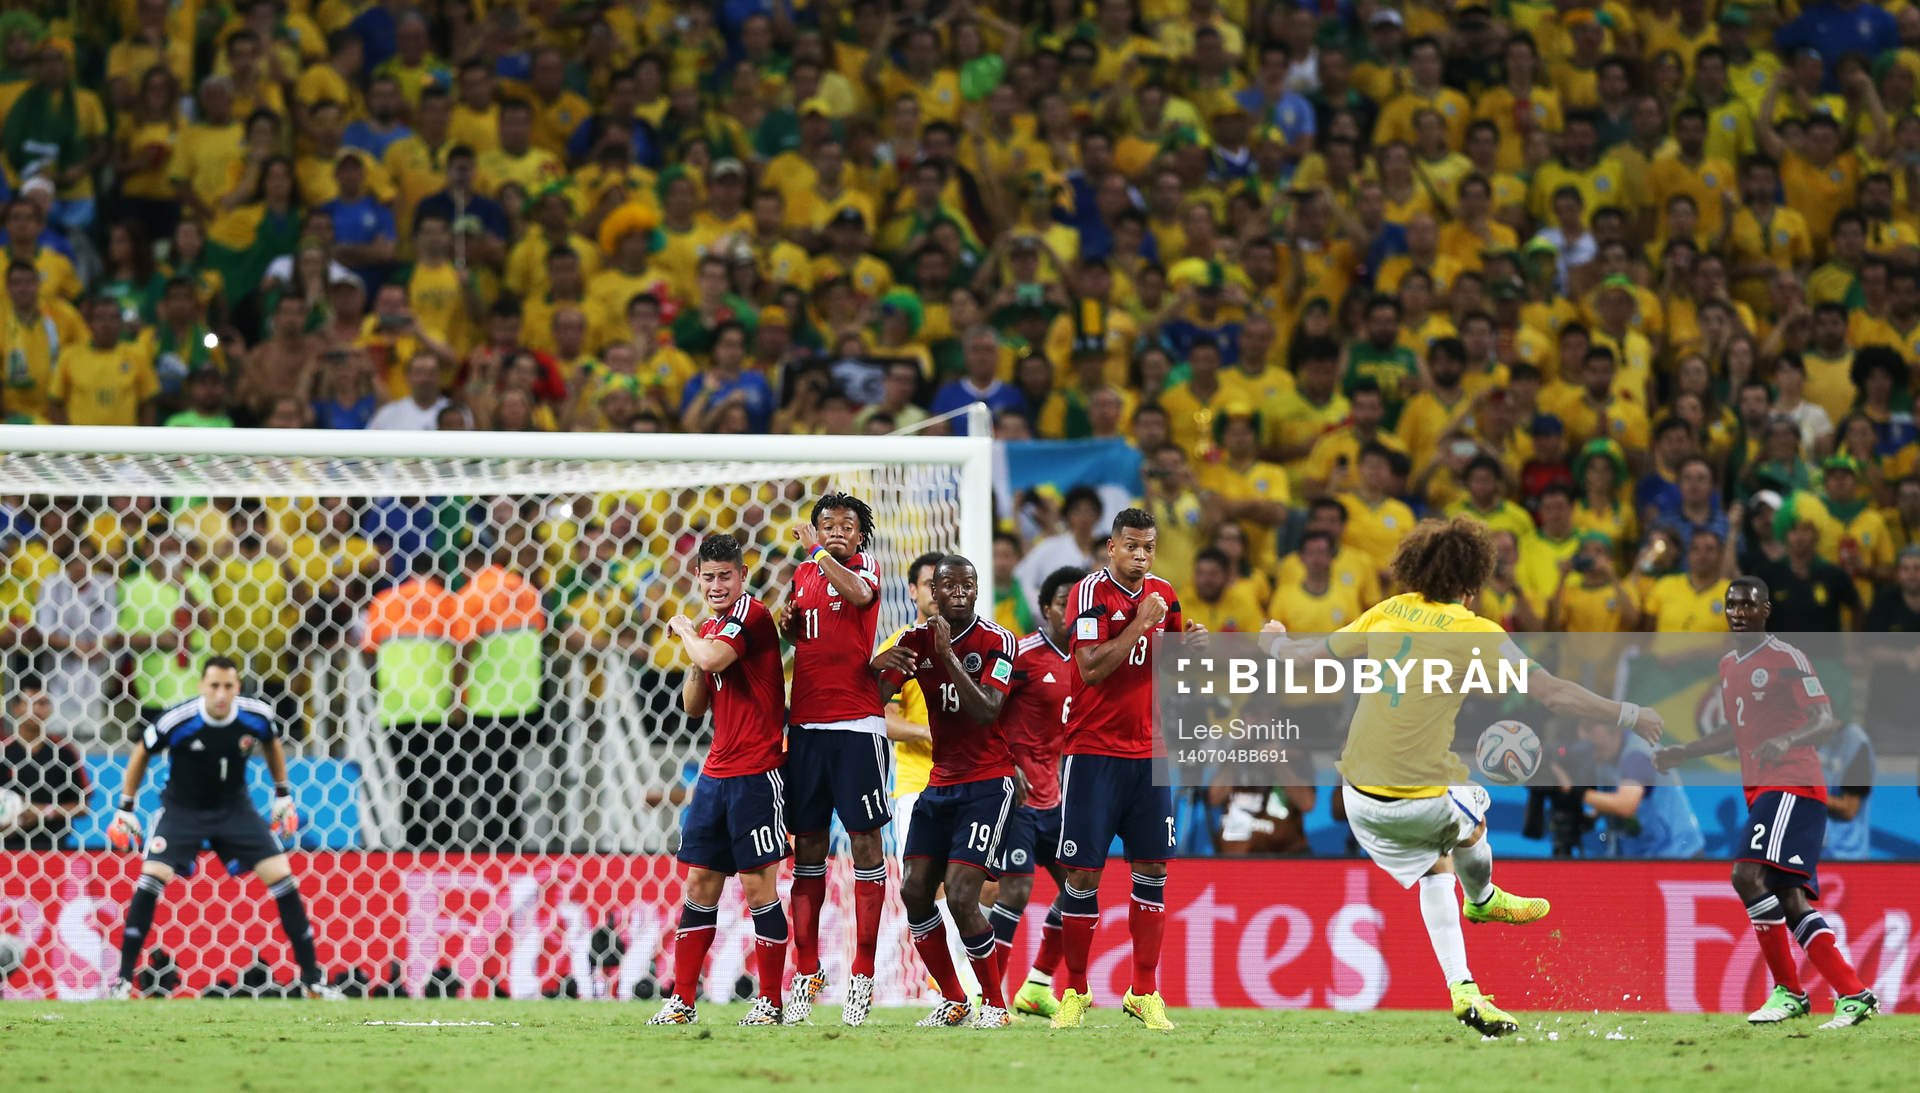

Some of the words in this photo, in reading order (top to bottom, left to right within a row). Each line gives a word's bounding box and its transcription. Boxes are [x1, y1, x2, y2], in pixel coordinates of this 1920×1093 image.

[805, 608, 818, 639] 11
[1383, 602, 1424, 623] DAVID
[1129, 635, 1147, 666] 13
[1380, 635, 1412, 708] 4
[939, 682, 960, 713] 19
[1735, 696, 1745, 727] 2
[219, 757, 228, 781] 1
[861, 789, 884, 820] 11
[750, 825, 775, 857] 10
[967, 821, 991, 852] 19
[1750, 823, 1766, 850] 2
